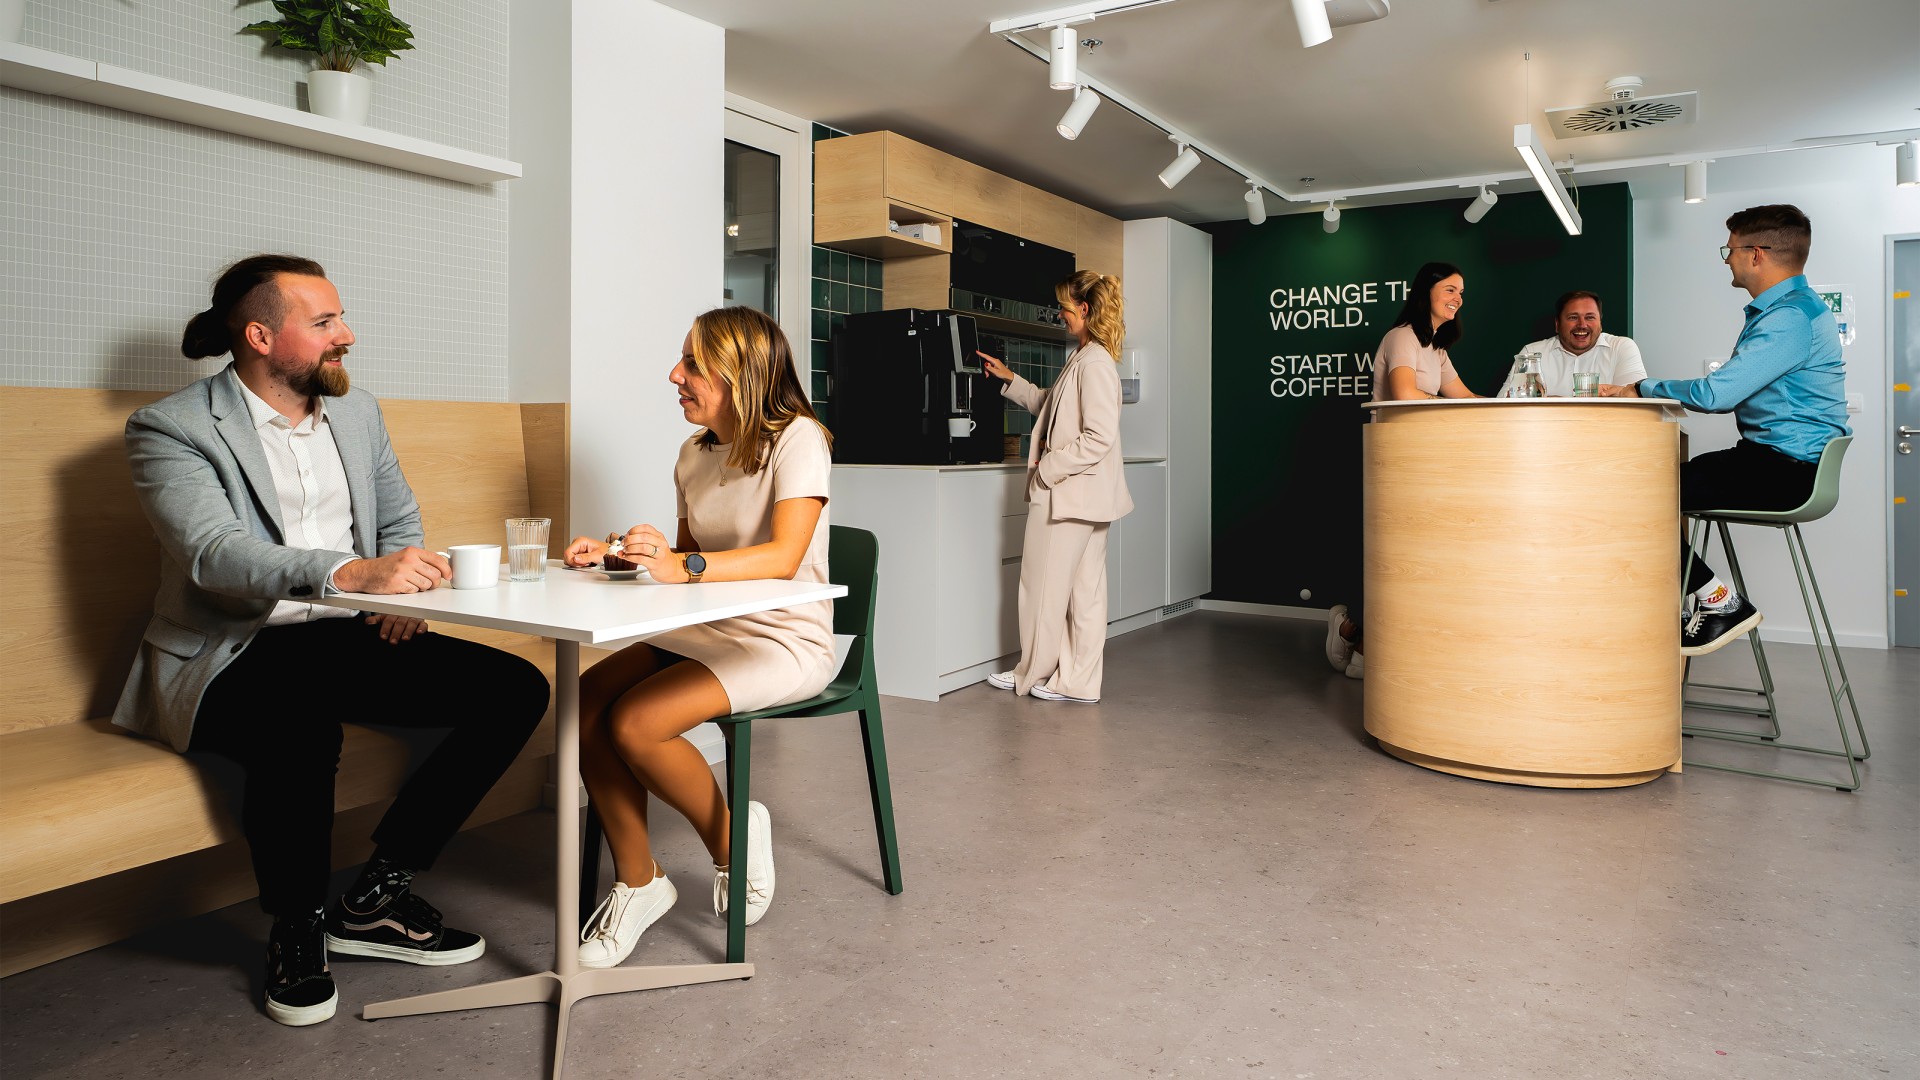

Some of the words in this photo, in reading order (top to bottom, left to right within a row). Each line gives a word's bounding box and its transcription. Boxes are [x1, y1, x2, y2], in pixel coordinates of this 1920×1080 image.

[1269, 282, 1378, 309] CHANGE
[1384, 280, 1412, 302] TH
[1269, 306, 1370, 331] WORLD.
[1270, 353, 1348, 376] START
